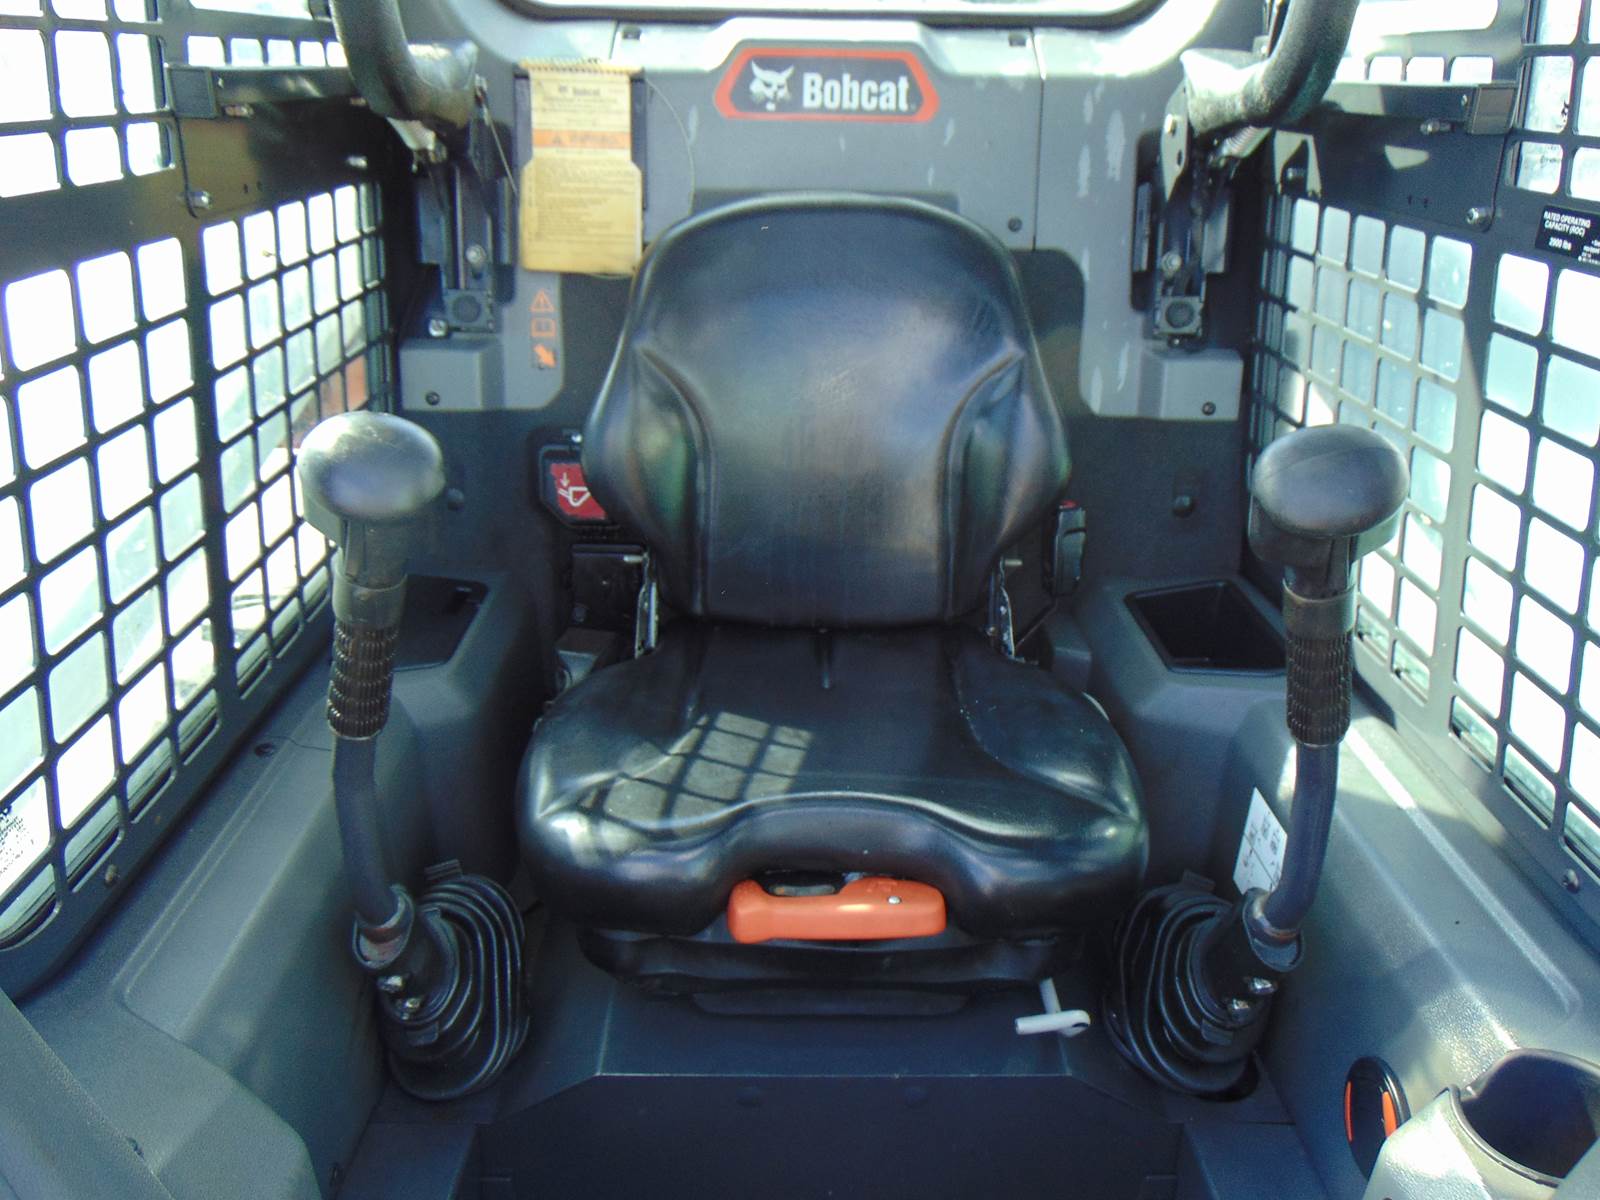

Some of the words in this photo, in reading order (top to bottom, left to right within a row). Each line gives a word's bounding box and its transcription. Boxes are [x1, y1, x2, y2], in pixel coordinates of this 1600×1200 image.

[802, 72, 910, 112] Bobcat
[1543, 211, 1560, 221] RATED
[1561, 214, 1591, 228] OPERATING
[1544, 220, 1569, 233] CAPACITY
[1569, 225, 1586, 238] (ROC)
